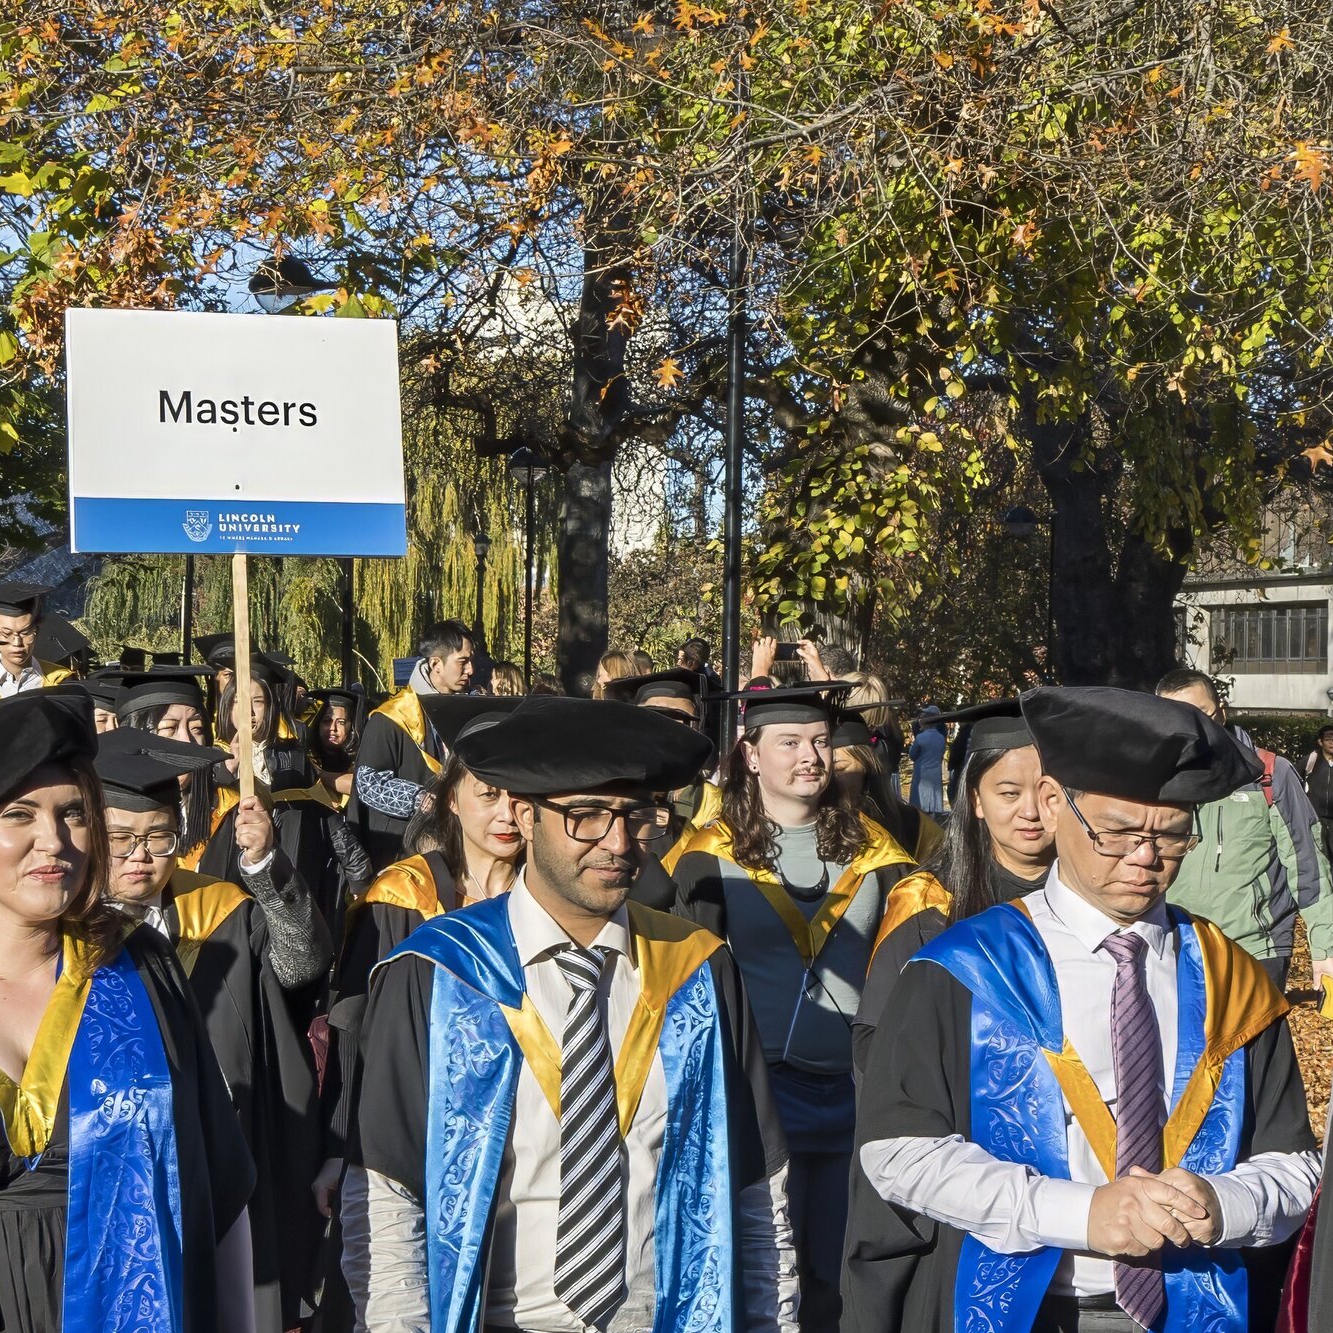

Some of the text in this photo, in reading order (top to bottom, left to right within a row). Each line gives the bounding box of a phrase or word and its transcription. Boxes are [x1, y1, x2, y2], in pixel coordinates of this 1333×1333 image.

[158, 389, 318, 427] Masters
[218, 513, 275, 523] LINCOLN
[218, 523, 301, 534] UNIVERSITY
